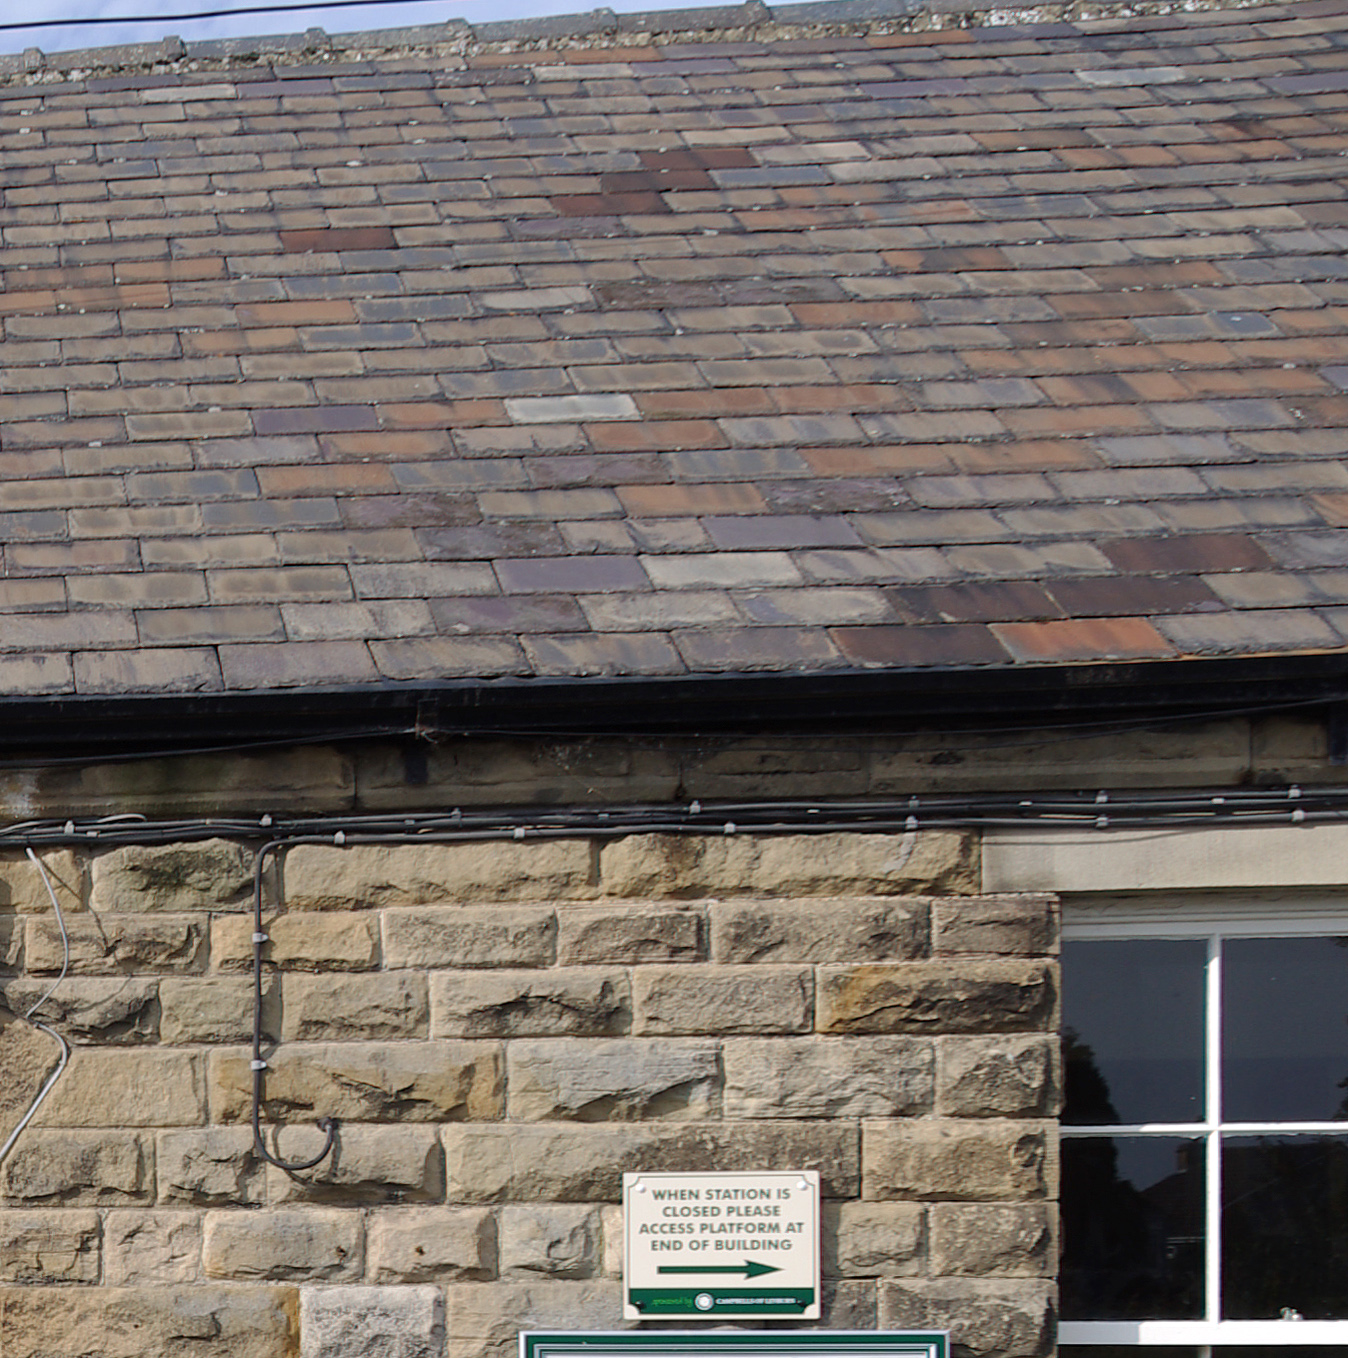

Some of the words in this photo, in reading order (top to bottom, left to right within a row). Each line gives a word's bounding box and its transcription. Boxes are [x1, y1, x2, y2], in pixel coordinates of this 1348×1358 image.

[652, 1189, 699, 1200] WHEN
[705, 1189, 770, 1200] STATION
[777, 1189, 791, 1199] IS
[662, 1206, 721, 1217] CLOSED
[726, 1206, 781, 1217] PLEASE
[638, 1223, 694, 1234] ACCESS
[699, 1222, 780, 1234] PLATFORM
[785, 1222, 805, 1233] AT
[651, 1240, 683, 1251] END
[688, 1240, 709, 1251] OF
[715, 1239, 792, 1250] BUILDING
